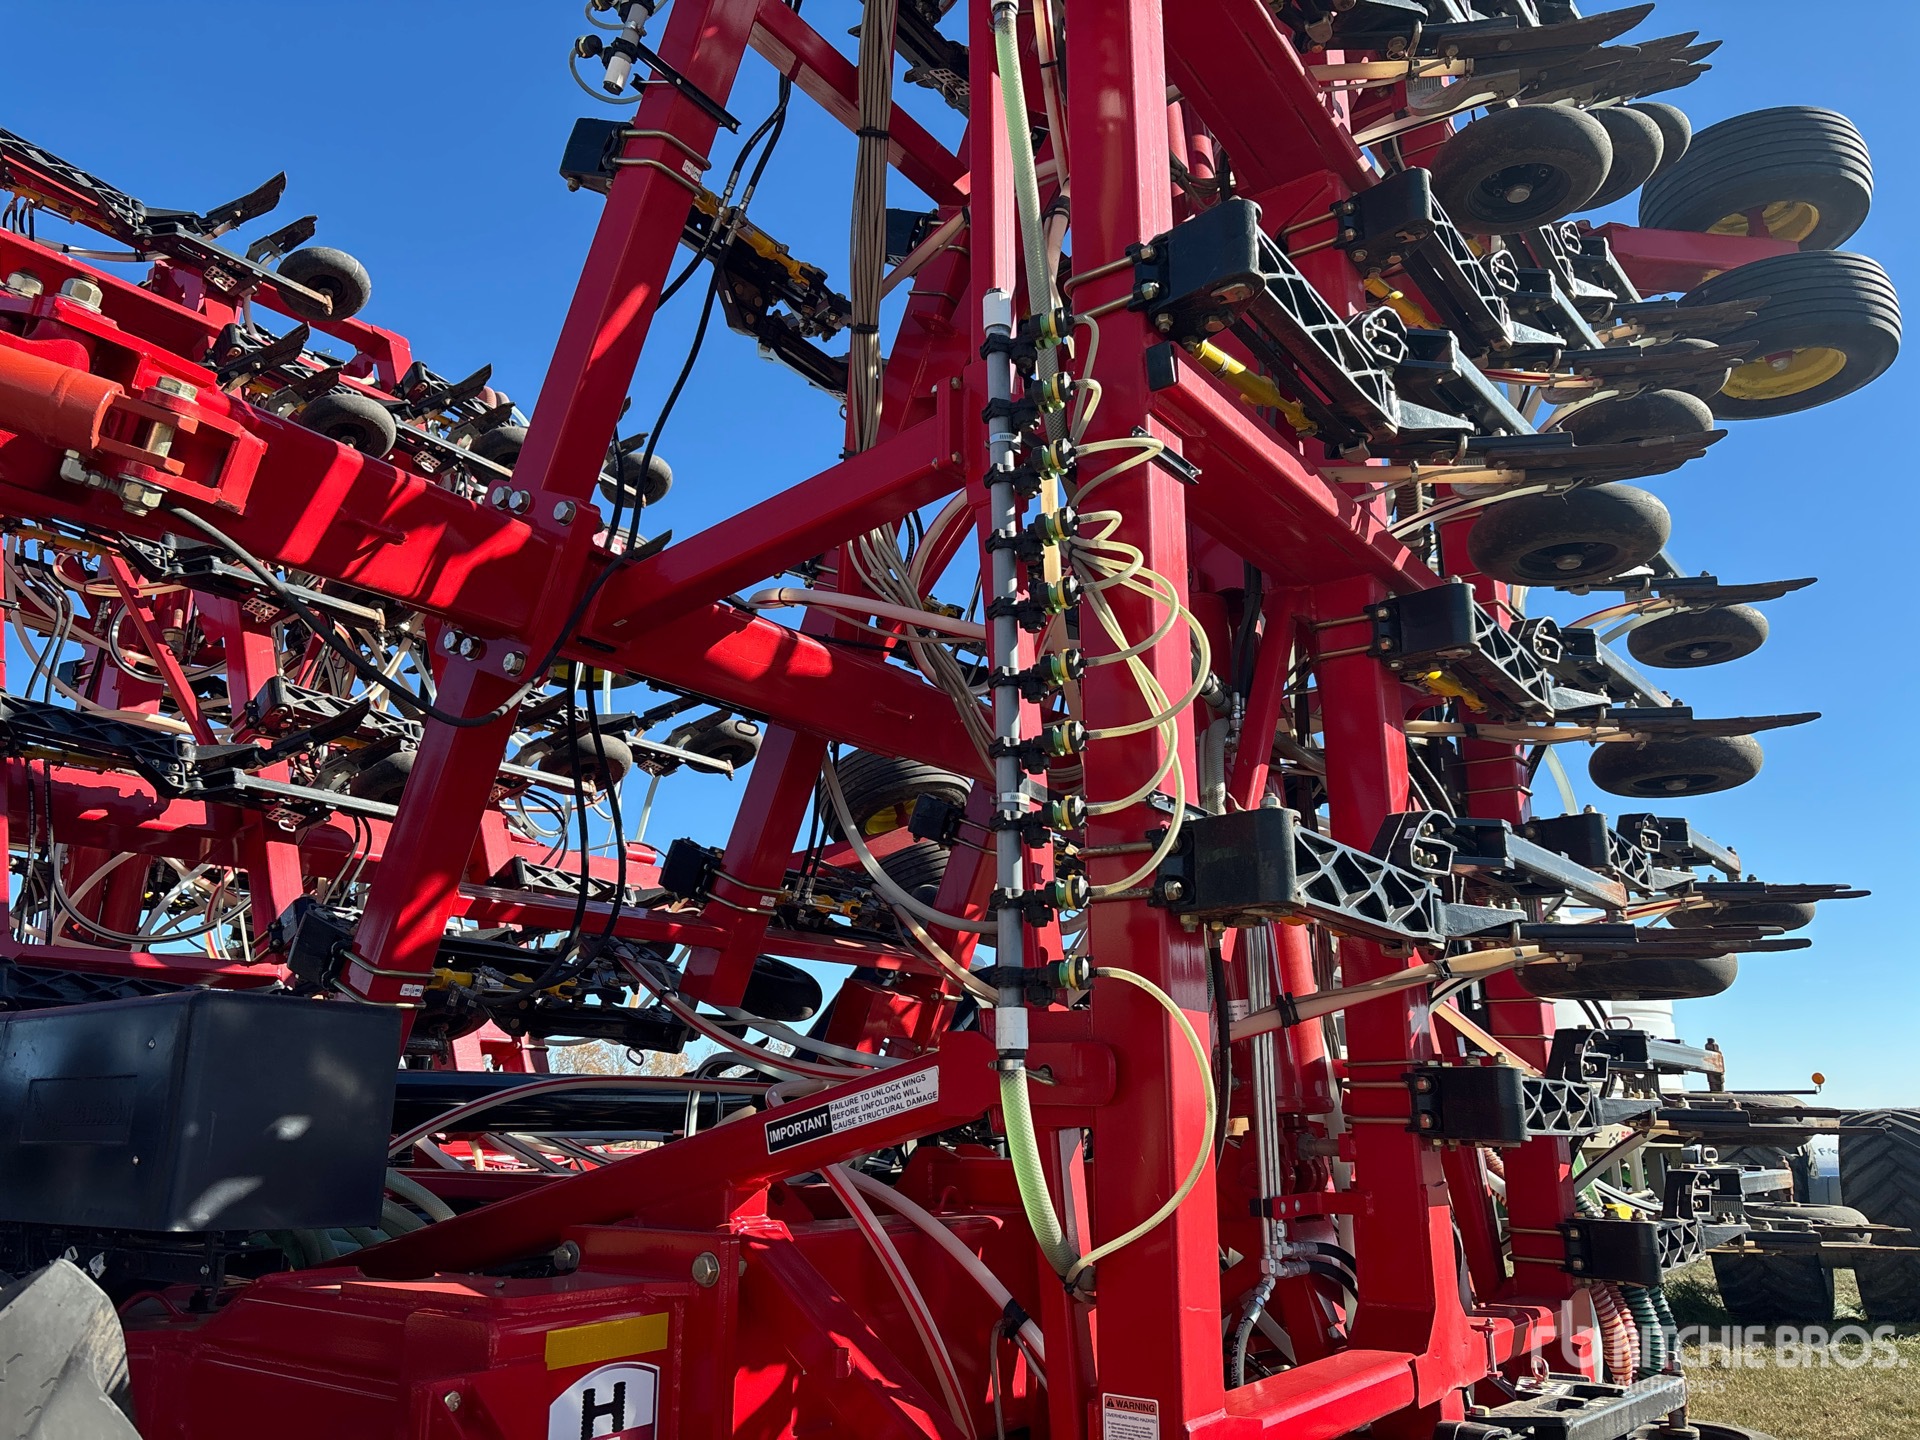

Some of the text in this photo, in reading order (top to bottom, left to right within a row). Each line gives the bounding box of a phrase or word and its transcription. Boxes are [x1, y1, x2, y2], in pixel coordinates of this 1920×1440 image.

[830, 1074, 926, 1112] FAILURE TO UNLOCK WINGS
[831, 1087, 921, 1122] BEFORE UNFOLDING WILL
[833, 1090, 938, 1131] CAUSE STRUCTURAL DAMAGE
[769, 1113, 828, 1144] IMPORTANT
[1115, 1399, 1155, 1413] WARNING
